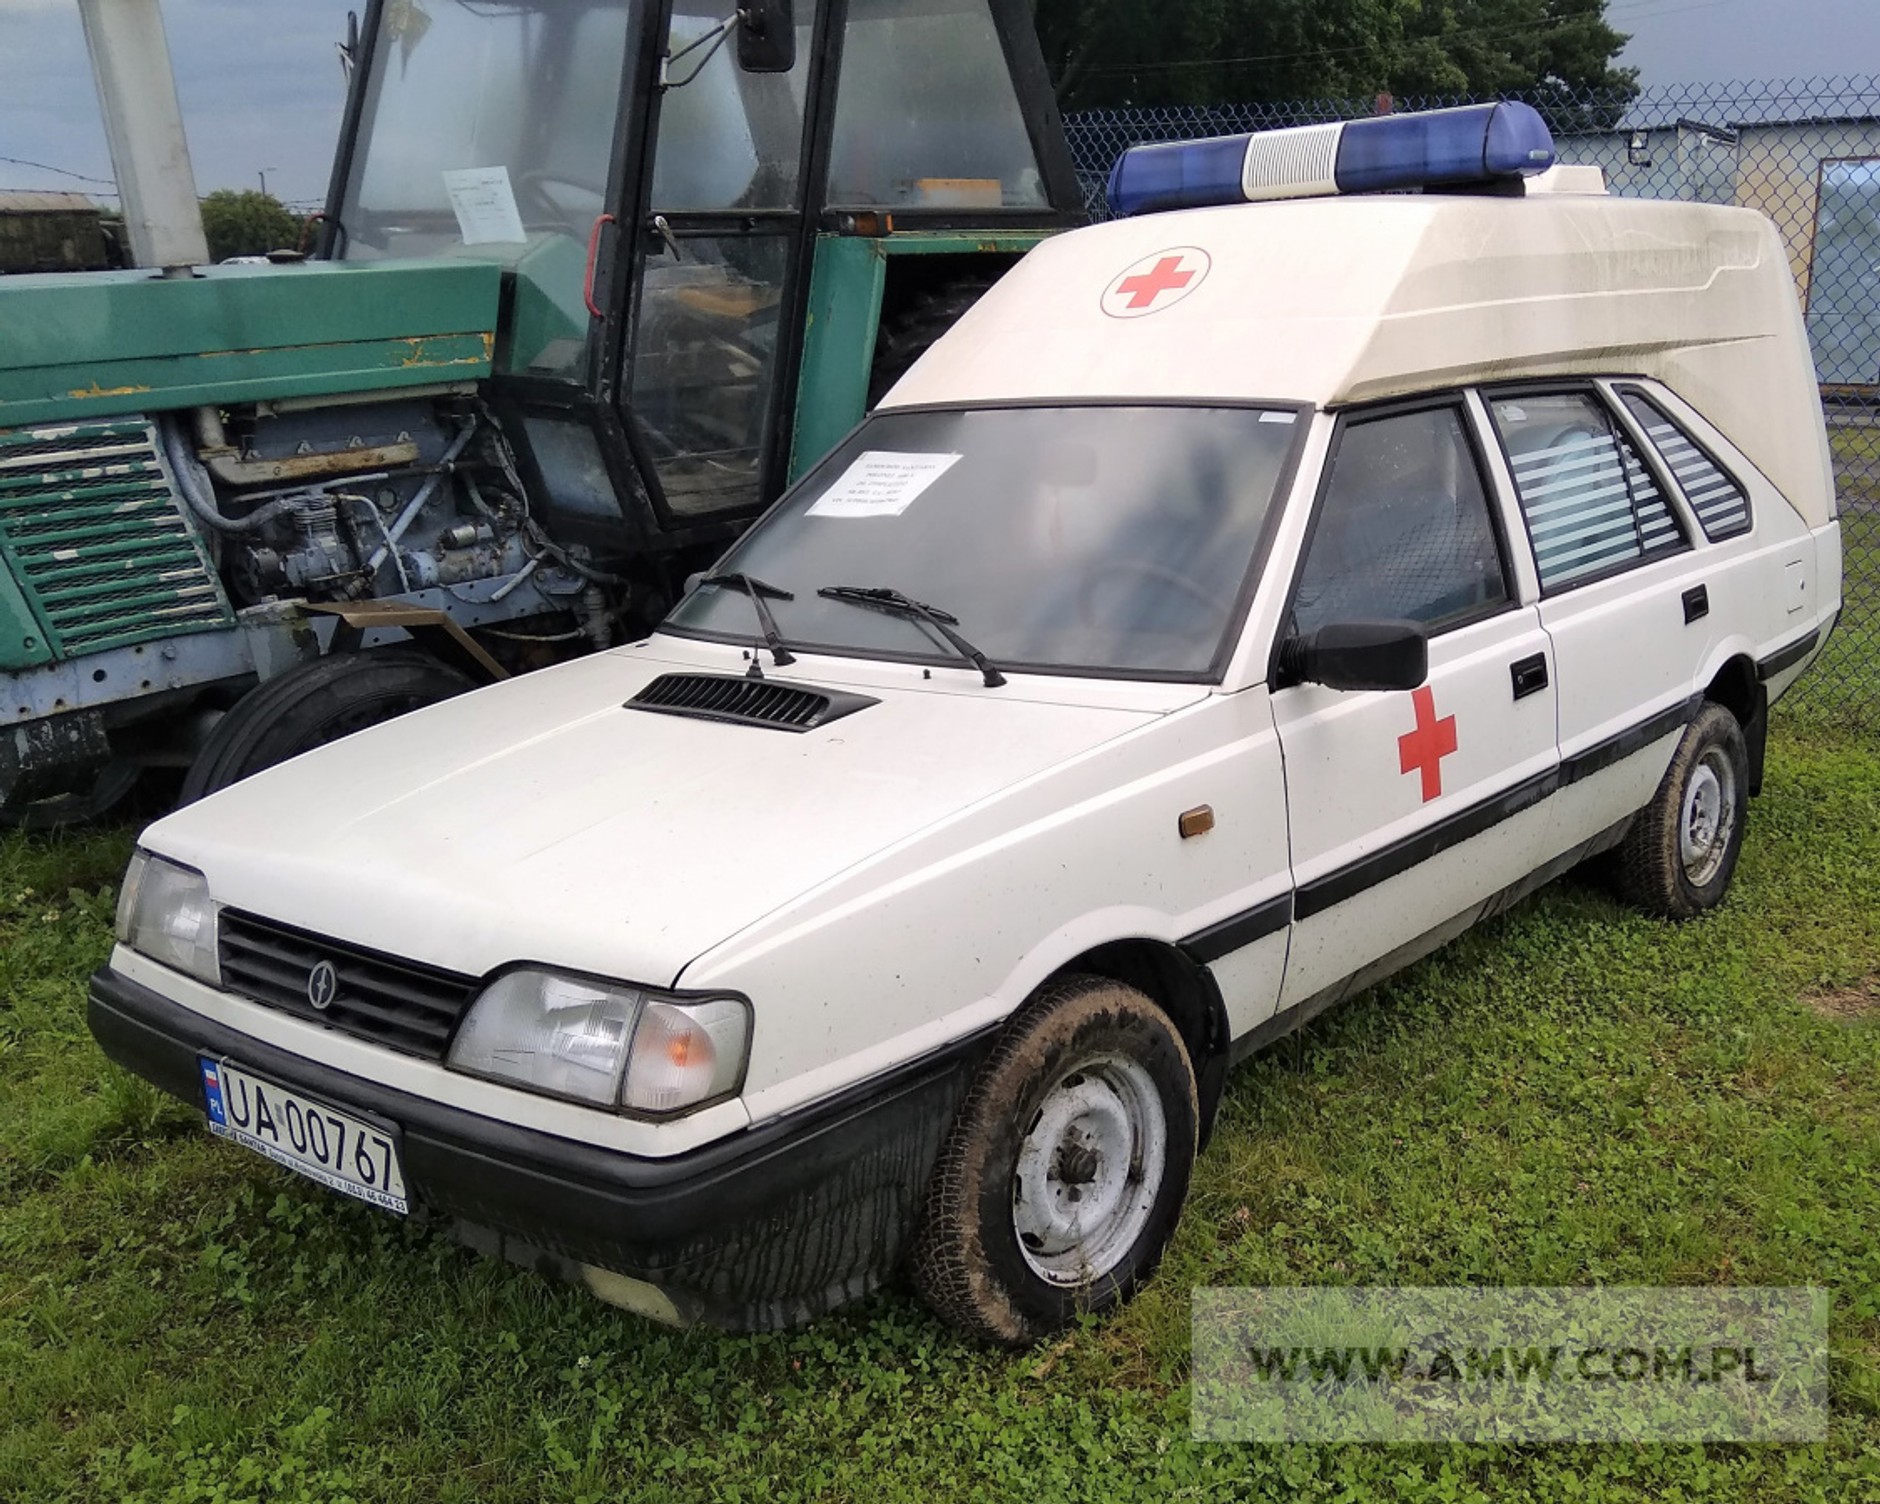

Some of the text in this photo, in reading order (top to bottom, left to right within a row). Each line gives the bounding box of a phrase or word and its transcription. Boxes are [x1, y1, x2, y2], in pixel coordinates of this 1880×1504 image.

[210, 1098, 223, 1115] PL
[223, 1072, 279, 1142] UA
[284, 1099, 391, 1191] 00767
